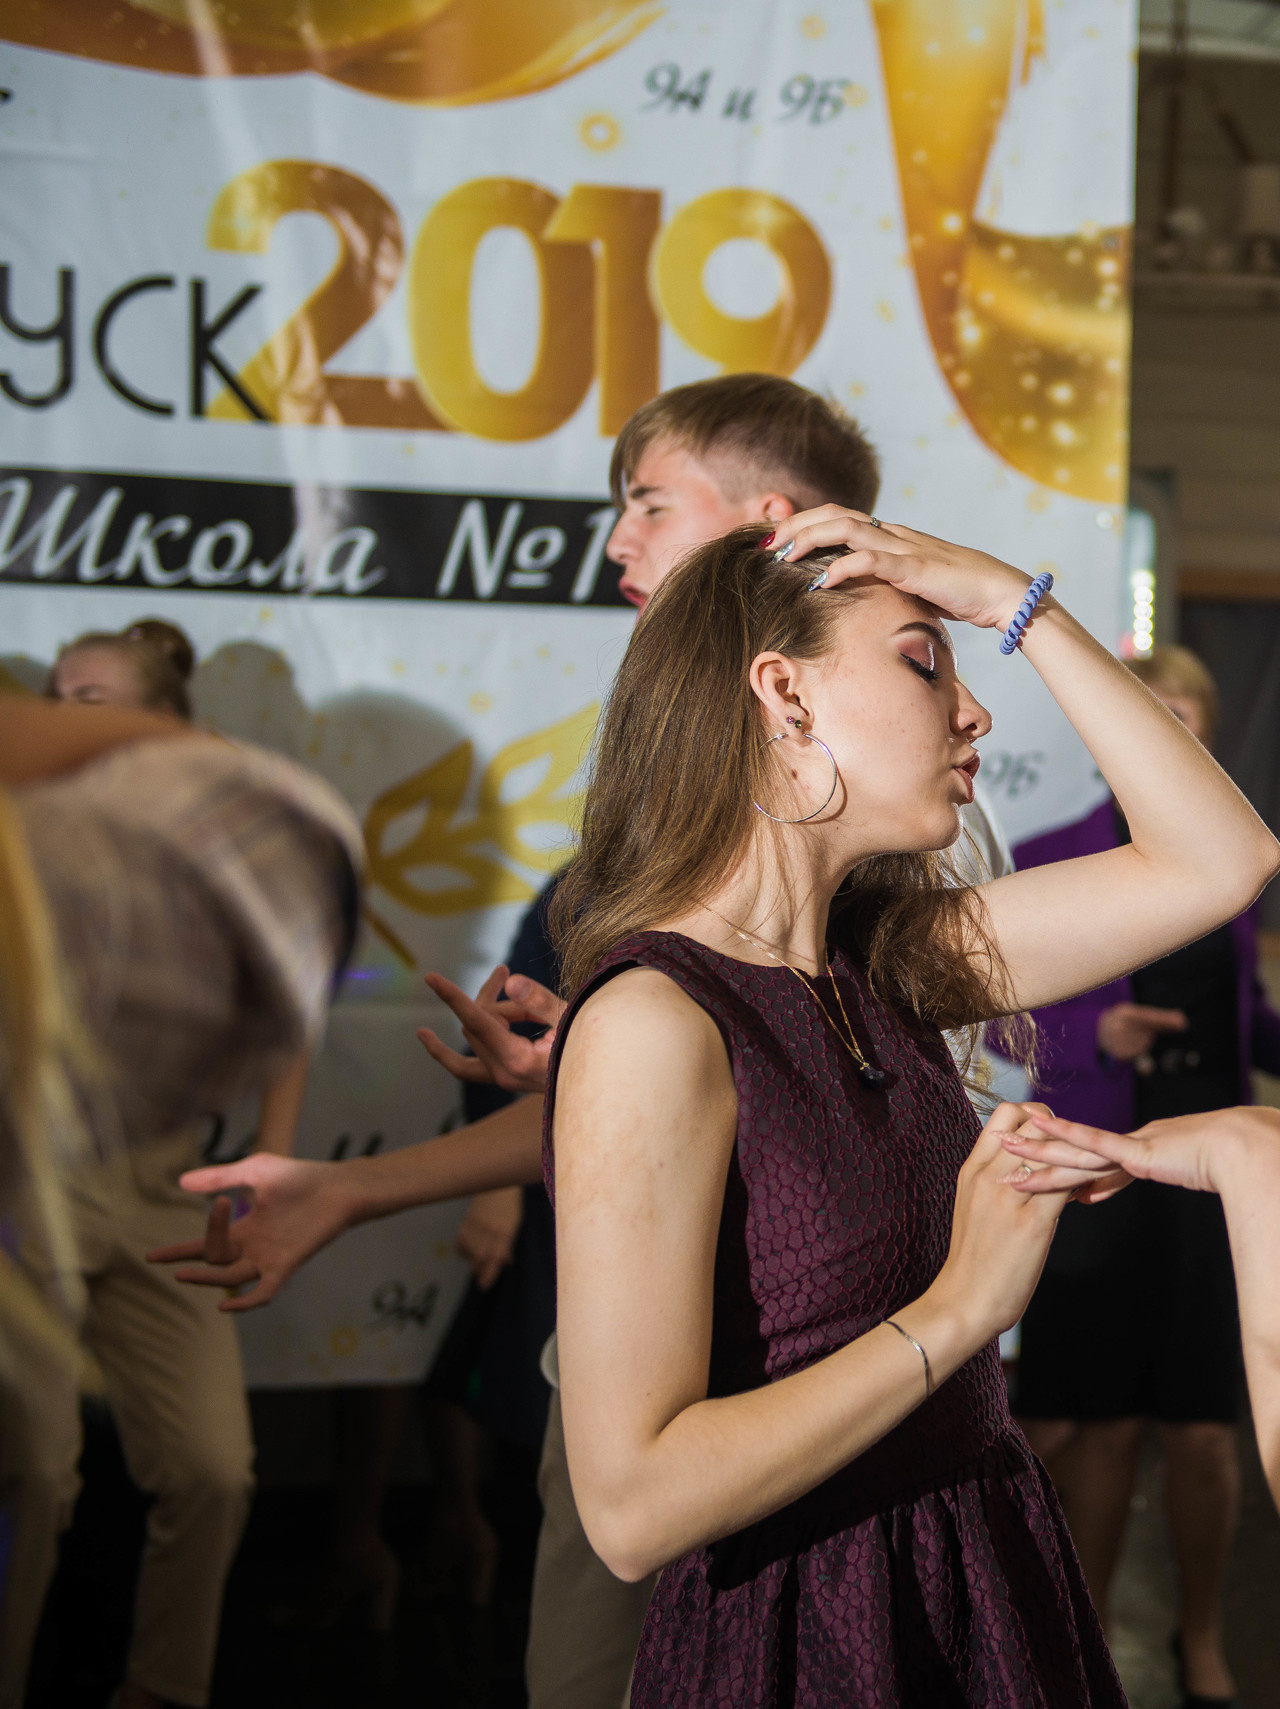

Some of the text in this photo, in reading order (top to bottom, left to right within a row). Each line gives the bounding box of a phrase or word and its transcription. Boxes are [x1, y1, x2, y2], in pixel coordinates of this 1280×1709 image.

[639, 62, 711, 115] 9А
[208, 158, 834, 443] 2019
[0, 476, 387, 594] Школа
